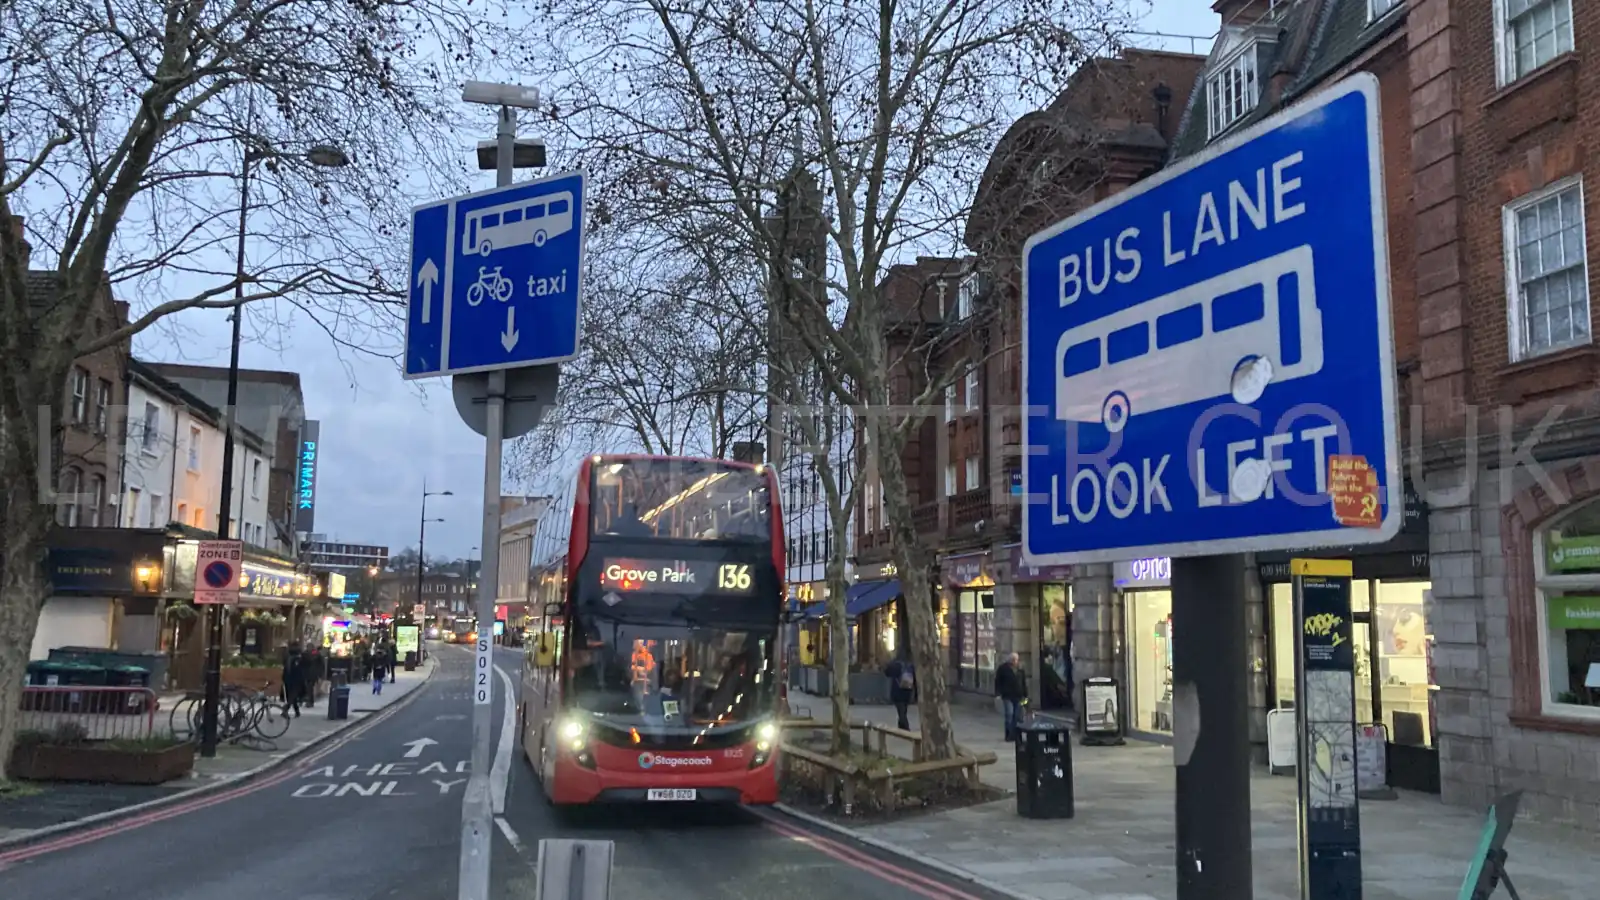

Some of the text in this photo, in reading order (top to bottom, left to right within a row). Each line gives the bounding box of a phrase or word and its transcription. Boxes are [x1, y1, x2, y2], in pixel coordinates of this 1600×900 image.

[1059, 150, 1306, 308] BUS LANE
[526, 268, 567, 298] taxi
[1332, 459, 1369, 471] Build the
[300, 441, 315, 509] PRIMARK
[1051, 425, 1337, 525] LOOK LEFT
[1349, 482, 1363, 492] the
[1333, 494, 1356, 506] arty.
[200, 542, 240, 550] Controlled
[200, 550, 229, 559] ZONE
[606, 564, 751, 589] Grove Park 136
[655, 755, 712, 768] Stagecoach
